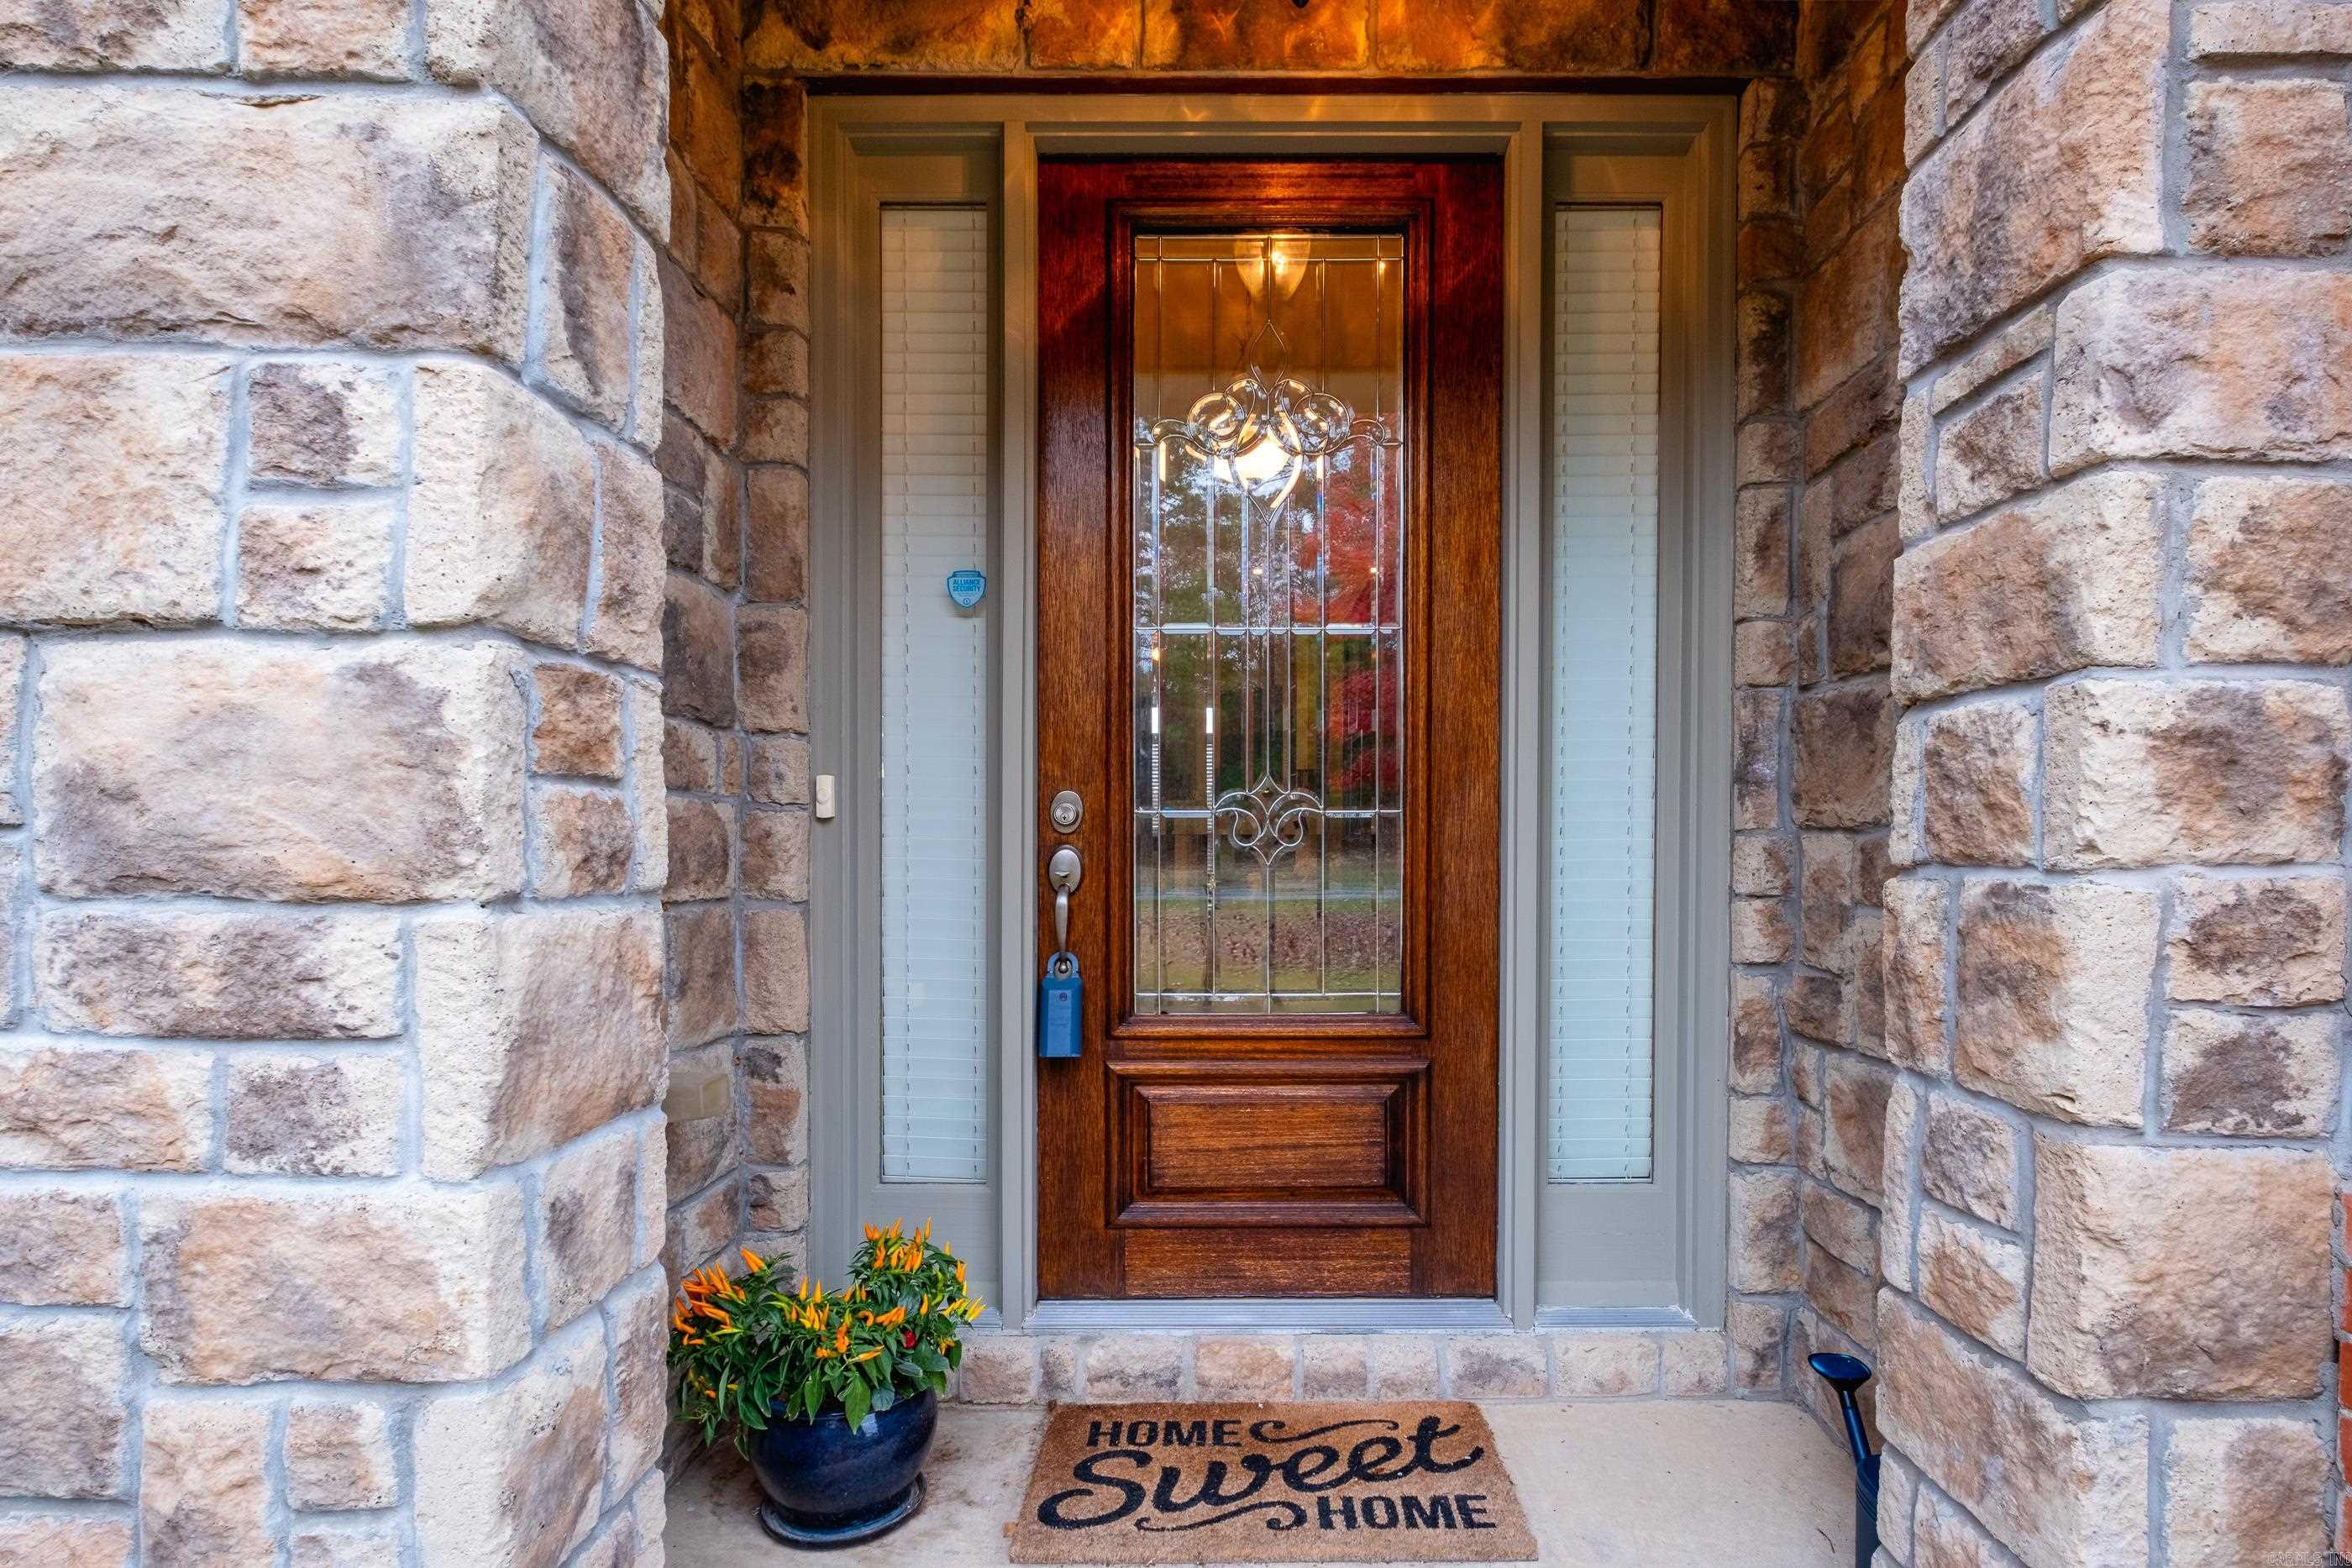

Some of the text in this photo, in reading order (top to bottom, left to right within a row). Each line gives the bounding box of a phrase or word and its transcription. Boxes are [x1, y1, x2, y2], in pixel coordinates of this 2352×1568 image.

[1086, 1419, 1242, 1448] HOME
[1037, 1416, 1484, 1530] Sweet
[1315, 1495, 1497, 1529] HOME
